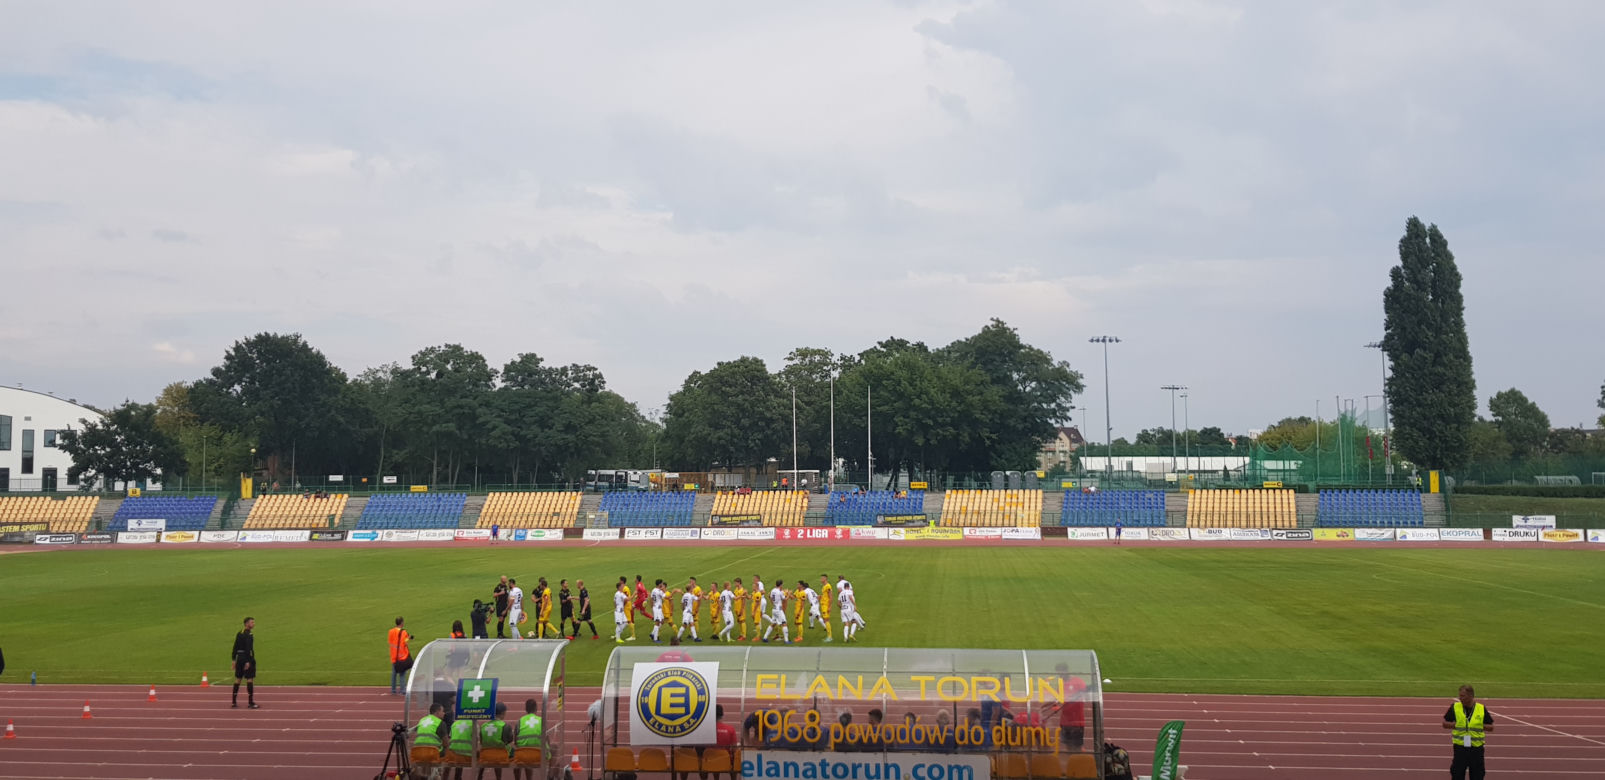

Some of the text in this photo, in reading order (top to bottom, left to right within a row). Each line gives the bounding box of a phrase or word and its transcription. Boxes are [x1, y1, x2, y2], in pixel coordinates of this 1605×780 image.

[797, 529, 829, 538] 2 LIGA
[1508, 530, 1536, 538] DRUKU
[756, 674, 1065, 703] ELANA TORUŃ
[660, 687, 686, 715] E
[649, 717, 682, 733] ELANA
[755, 709, 1062, 757] 1968 powodów do dumy
